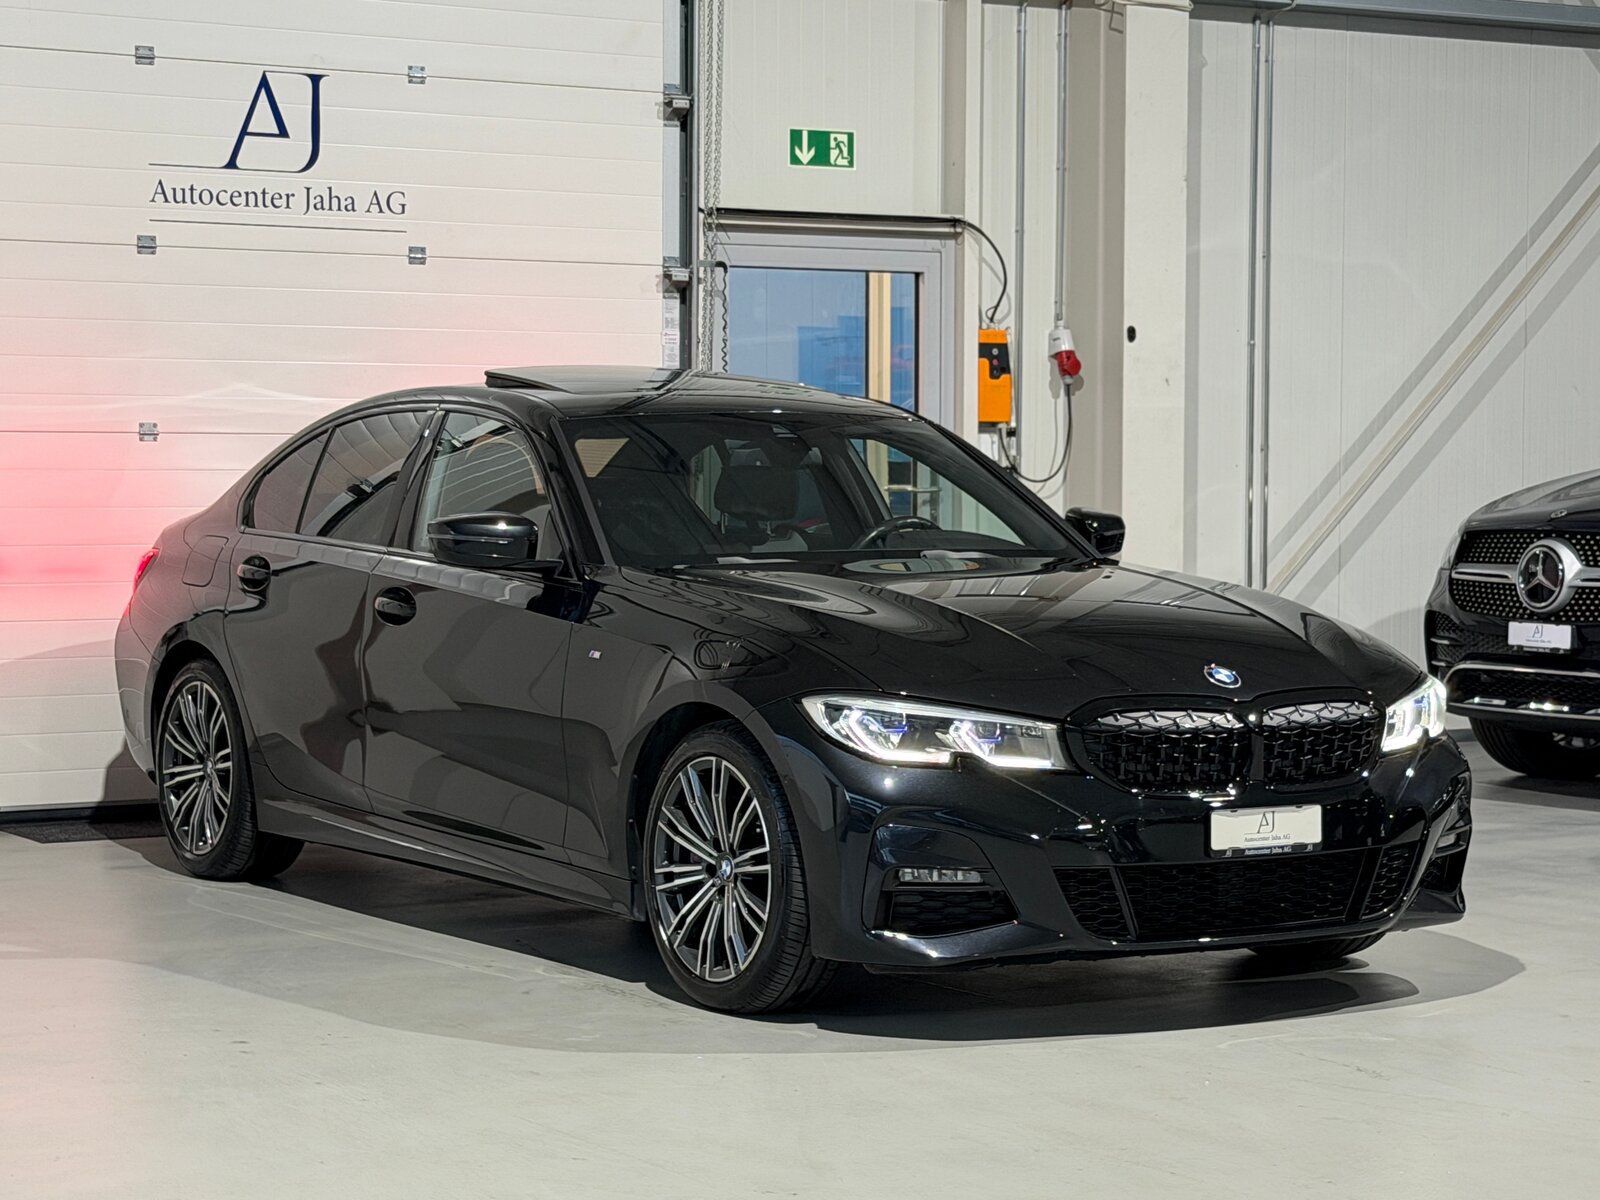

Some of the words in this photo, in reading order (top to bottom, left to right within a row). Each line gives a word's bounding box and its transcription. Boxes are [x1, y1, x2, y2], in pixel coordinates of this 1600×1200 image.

[221, 70, 330, 173] AJ
[149, 178, 295, 210] Autocenter
[303, 186, 357, 215] Jaha
[365, 190, 407, 215] AG
[1257, 811, 1275, 834] AJ
